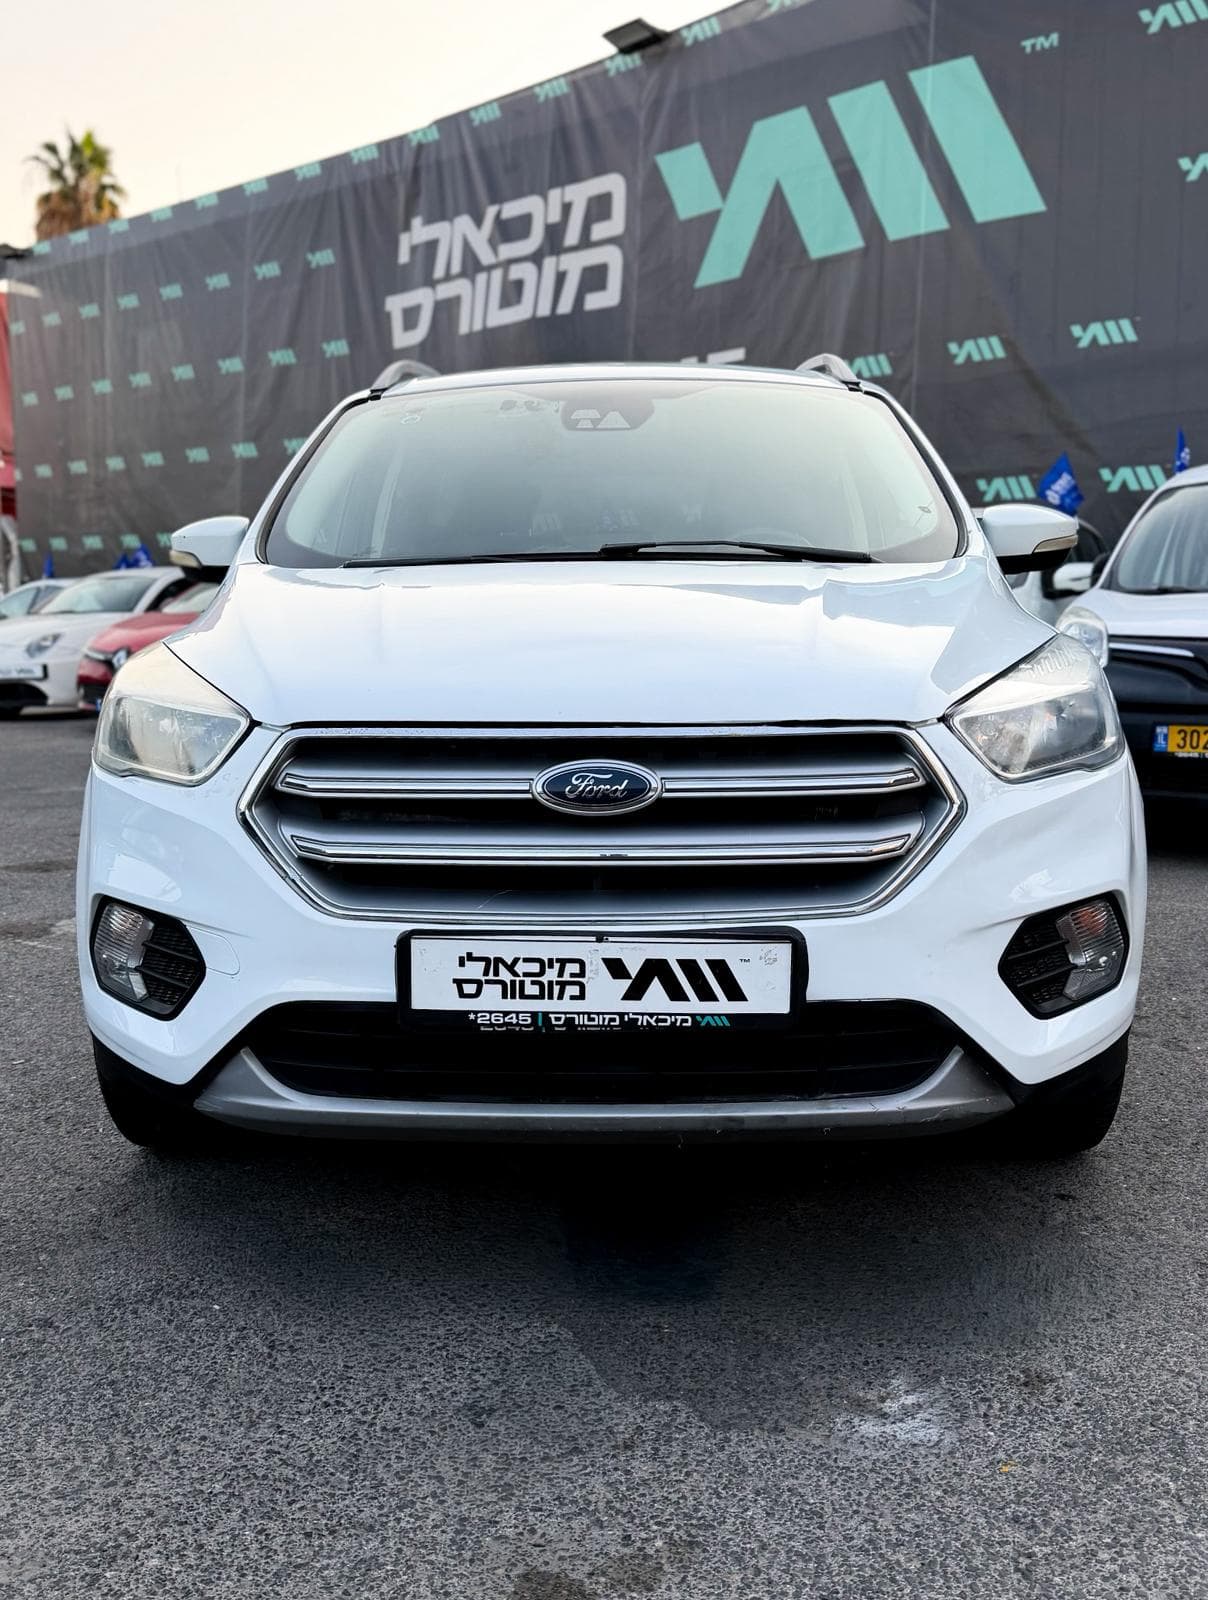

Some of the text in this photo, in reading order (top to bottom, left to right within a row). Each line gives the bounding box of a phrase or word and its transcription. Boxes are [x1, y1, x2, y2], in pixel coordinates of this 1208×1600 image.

[398, 172, 626, 280] מיכאלי
[384, 244, 623, 349] מוטורס
[565, 772, 629, 799] Ford
[458, 952, 586, 978] מיכאלי
[452, 978, 586, 1001] מוטורס
[548, 1014, 620, 1025] מוטורס
[624, 1013, 692, 1026] מיכאלי
